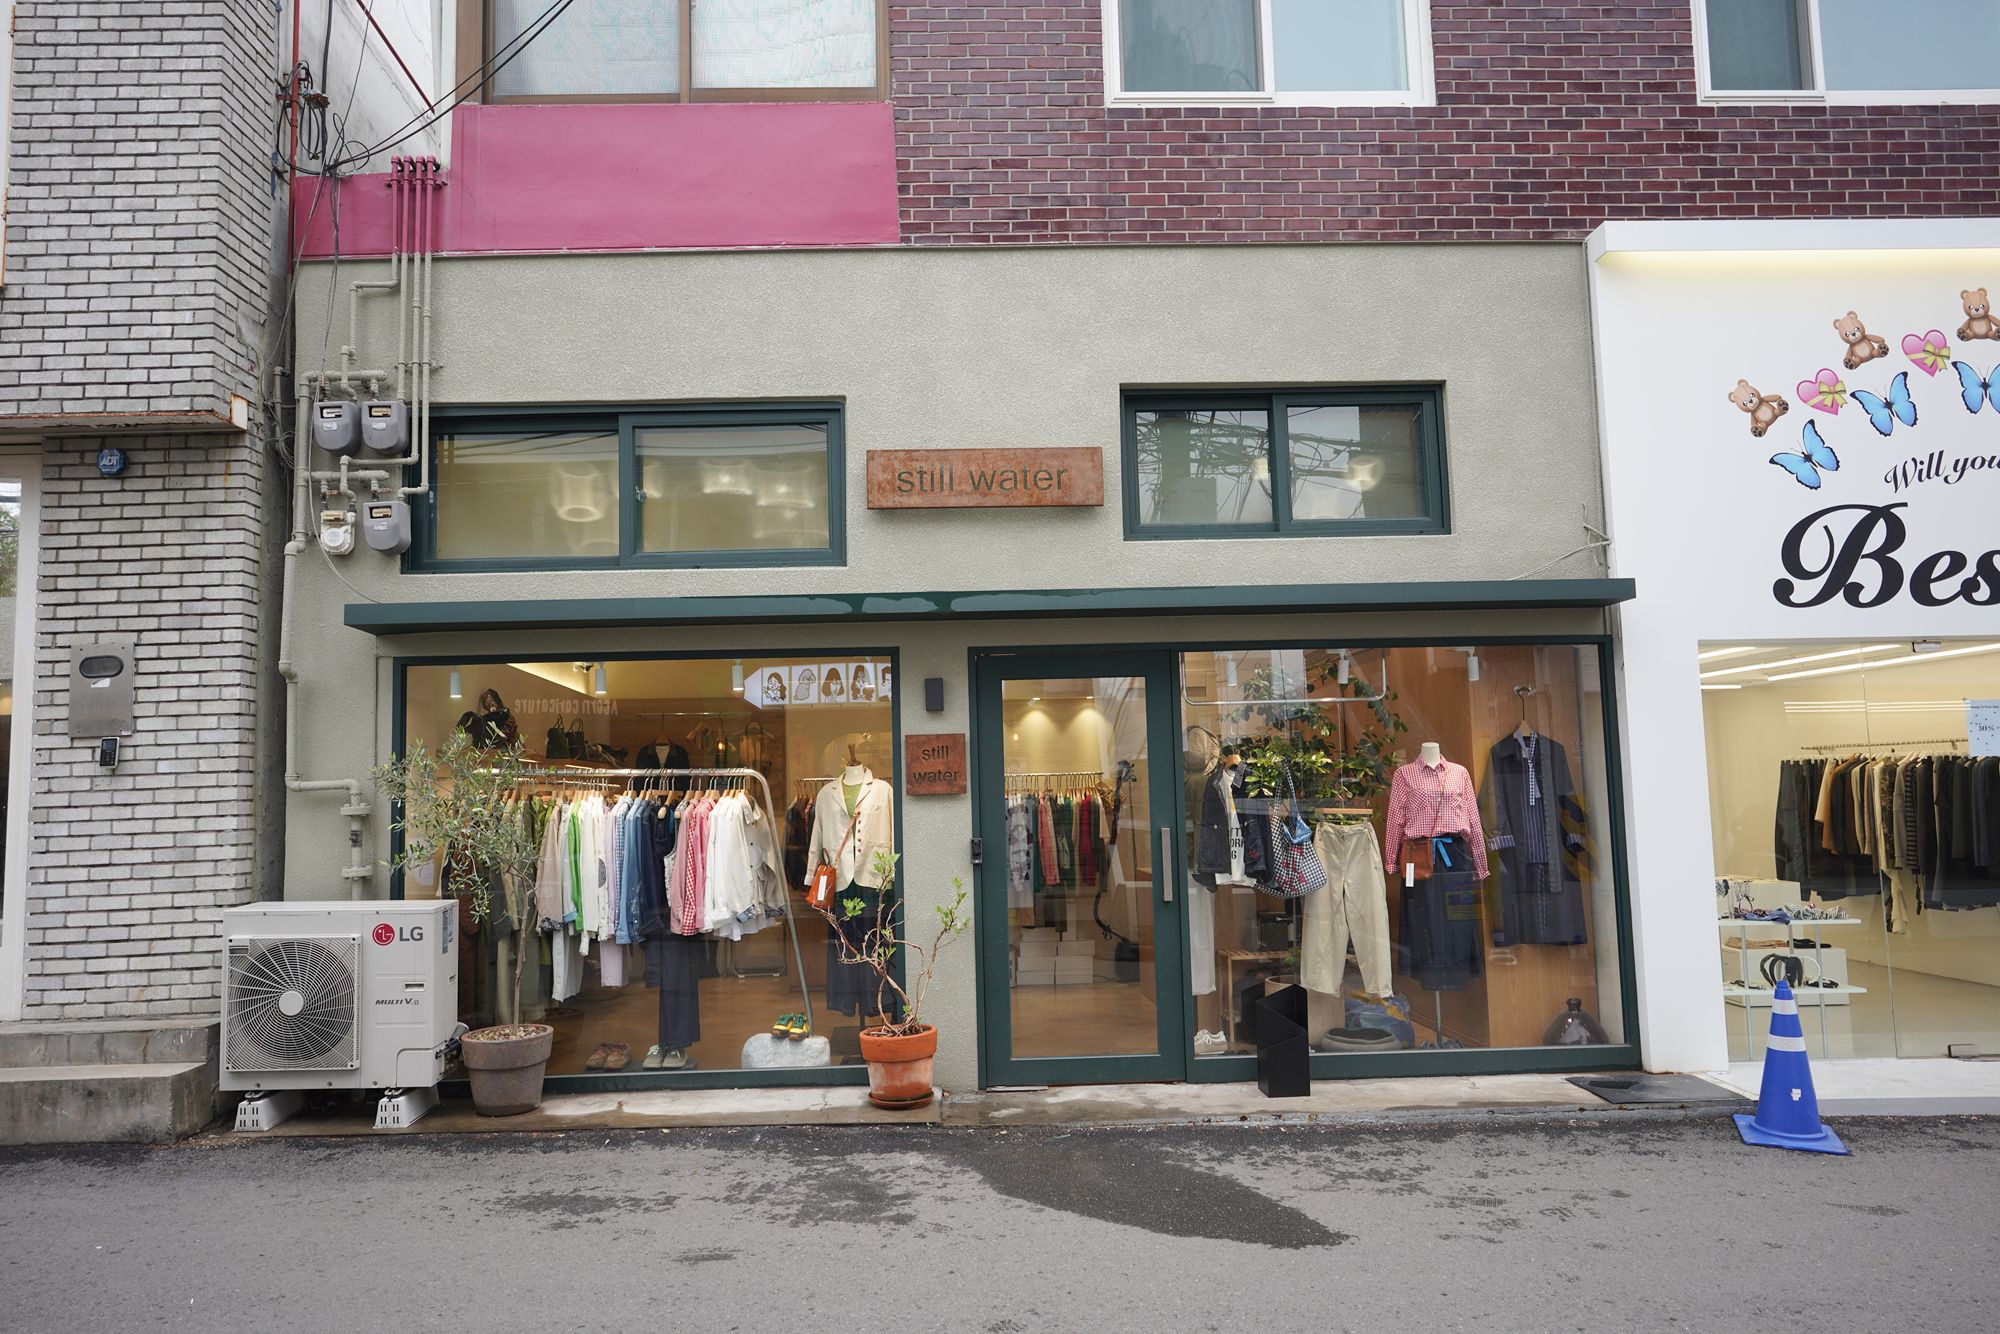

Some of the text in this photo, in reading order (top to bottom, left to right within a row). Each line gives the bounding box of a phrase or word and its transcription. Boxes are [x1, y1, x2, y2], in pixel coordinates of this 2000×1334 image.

[100, 456, 119, 466] ADT
[896, 463, 1068, 493] still water
[1884, 450, 1946, 494] Will
[1773, 502, 2000, 609] Bes
[921, 745, 949, 760] still
[913, 769, 960, 783] water
[399, 926, 424, 942] LG
